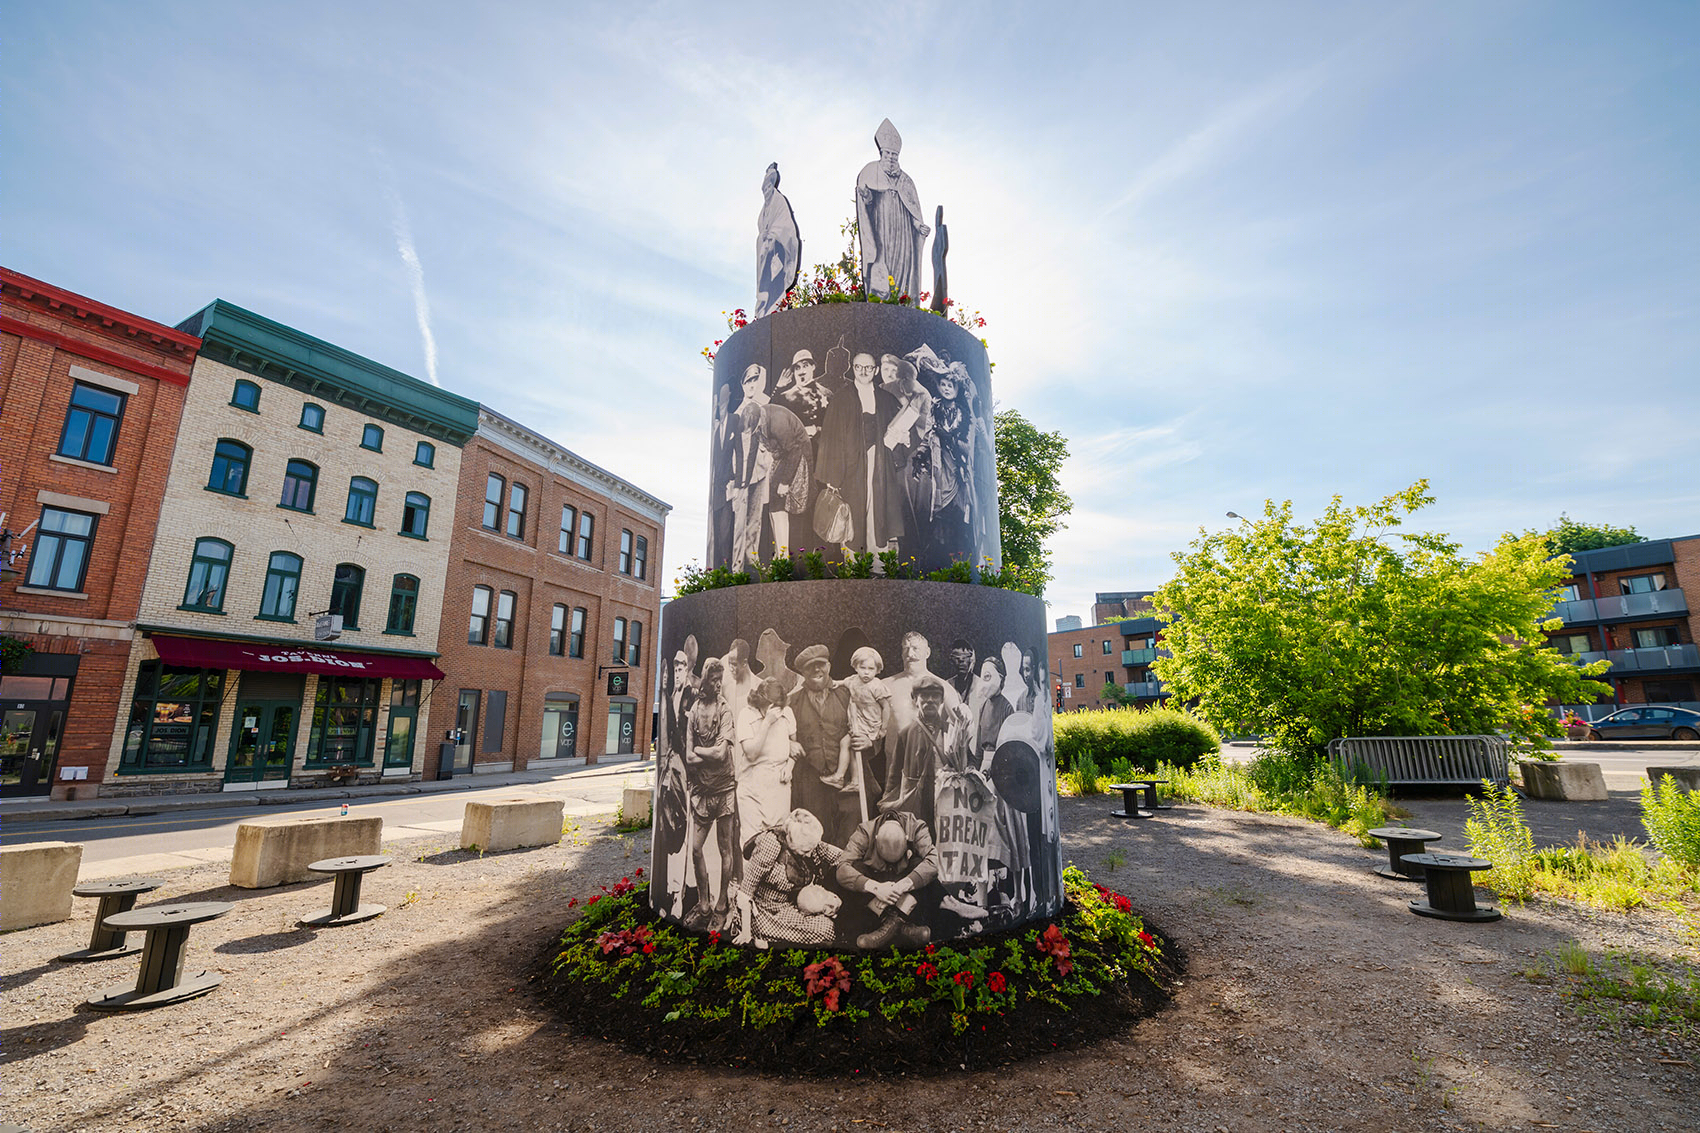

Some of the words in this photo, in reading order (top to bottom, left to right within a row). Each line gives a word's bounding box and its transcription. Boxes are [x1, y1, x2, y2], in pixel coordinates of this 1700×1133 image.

[953, 787, 983, 813] NO
[939, 814, 988, 849] BREAD
[942, 850, 983, 878] TAX
